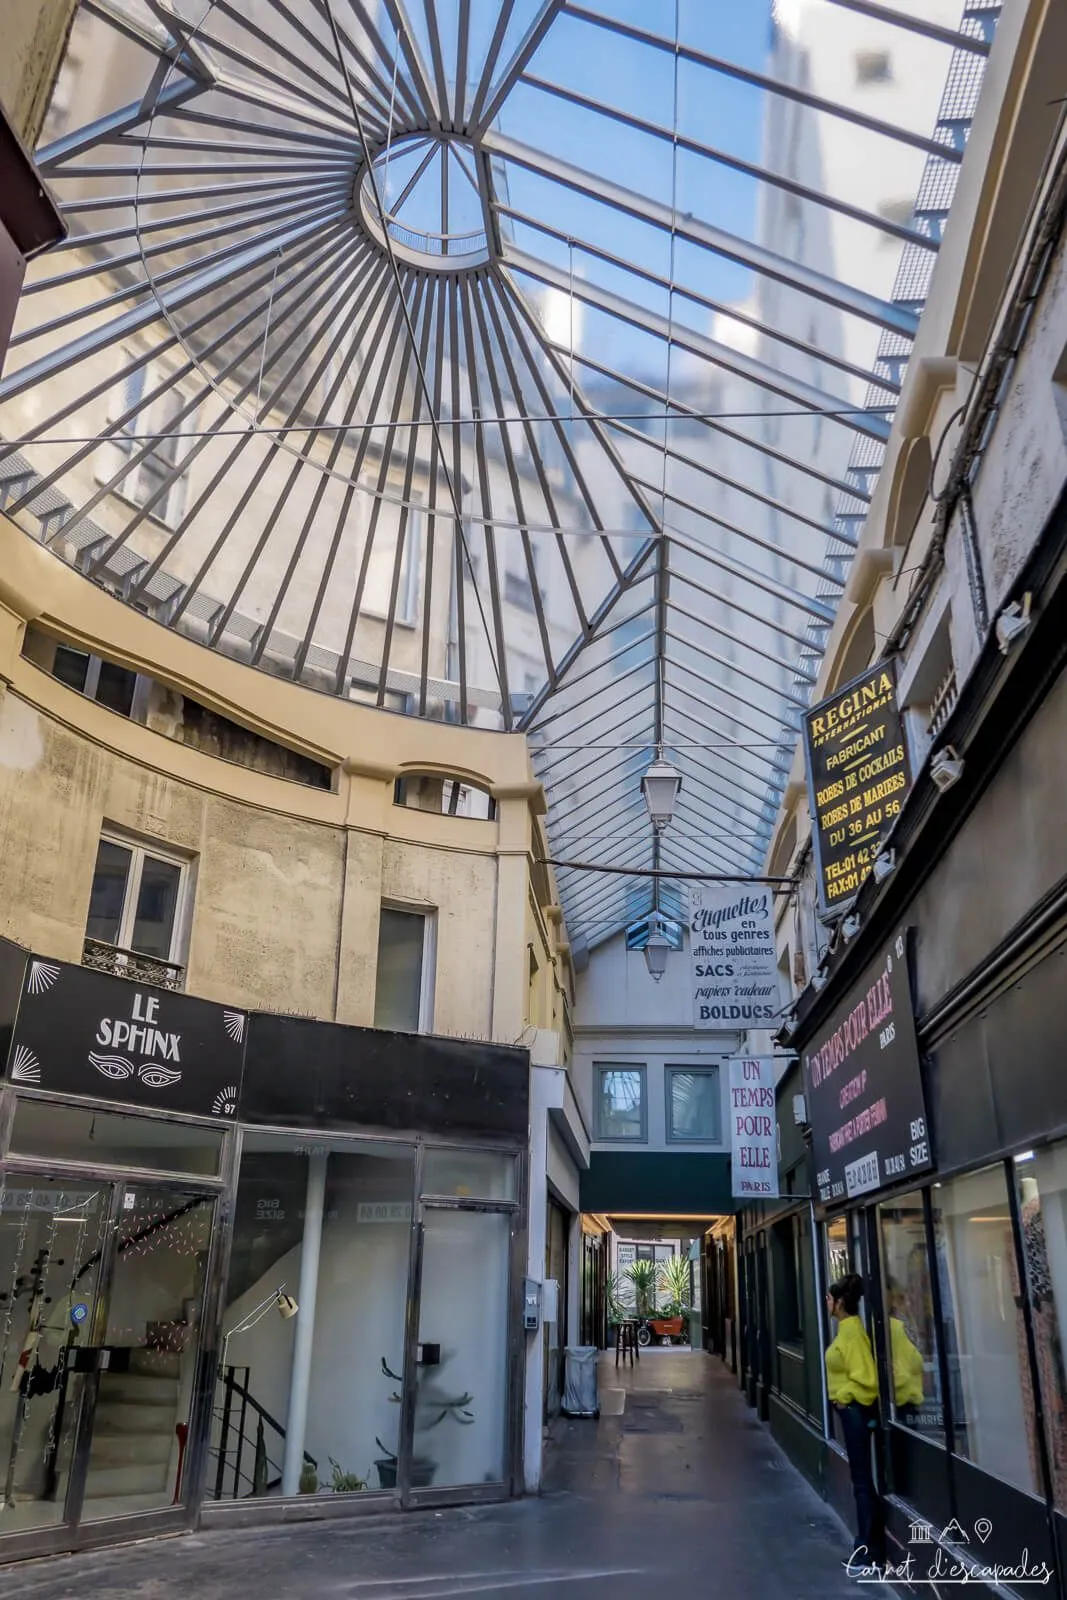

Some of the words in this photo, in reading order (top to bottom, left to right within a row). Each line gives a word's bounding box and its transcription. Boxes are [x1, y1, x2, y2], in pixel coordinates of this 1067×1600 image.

[811, 673, 892, 739] REGINA
[813, 691, 894, 748] INTERNATIONAL
[826, 724, 886, 771] FABRICANT
[816, 780, 844, 807] ROBES
[844, 771, 858, 792] DE
[858, 745, 905, 782] COCKAILS
[821, 803, 849, 830] ROBES
[849, 795, 863, 814] DE
[863, 771, 906, 807] MARIEES
[829, 828, 846, 848] DU
[848, 819, 863, 837] 36
[865, 808, 883, 829] AU
[885, 799, 900, 818] 56
[825, 854, 857, 881] TEL:01
[857, 847, 870, 864] 42
[827, 871, 859, 899] FAX:01
[703, 930, 728, 941] tous
[730, 930, 770, 943] genres
[741, 920, 756, 929] en
[693, 946, 724, 957] affiches
[725, 946, 774, 958] publicitaires
[695, 964, 735, 977] SACS
[694, 985, 732, 1000] papiers
[131, 993, 160, 1025] LE
[700, 1004, 774, 1020] BOLDUCS
[95, 1017, 182, 1062] SPHINX
[820, 1026, 845, 1080] TEMPS
[843, 1001, 870, 1058] POUR
[879, 1022, 896, 1050] PARIS
[742, 1061, 761, 1081] UN
[224, 1103, 236, 1115] 97
[732, 1087, 775, 1108] TEMPS
[736, 1115, 772, 1137] POUR
[910, 1117, 926, 1141] BIG
[740, 1147, 771, 1169] ELLE
[910, 1142, 929, 1167] SIZE
[741, 1181, 771, 1193] PARIS
